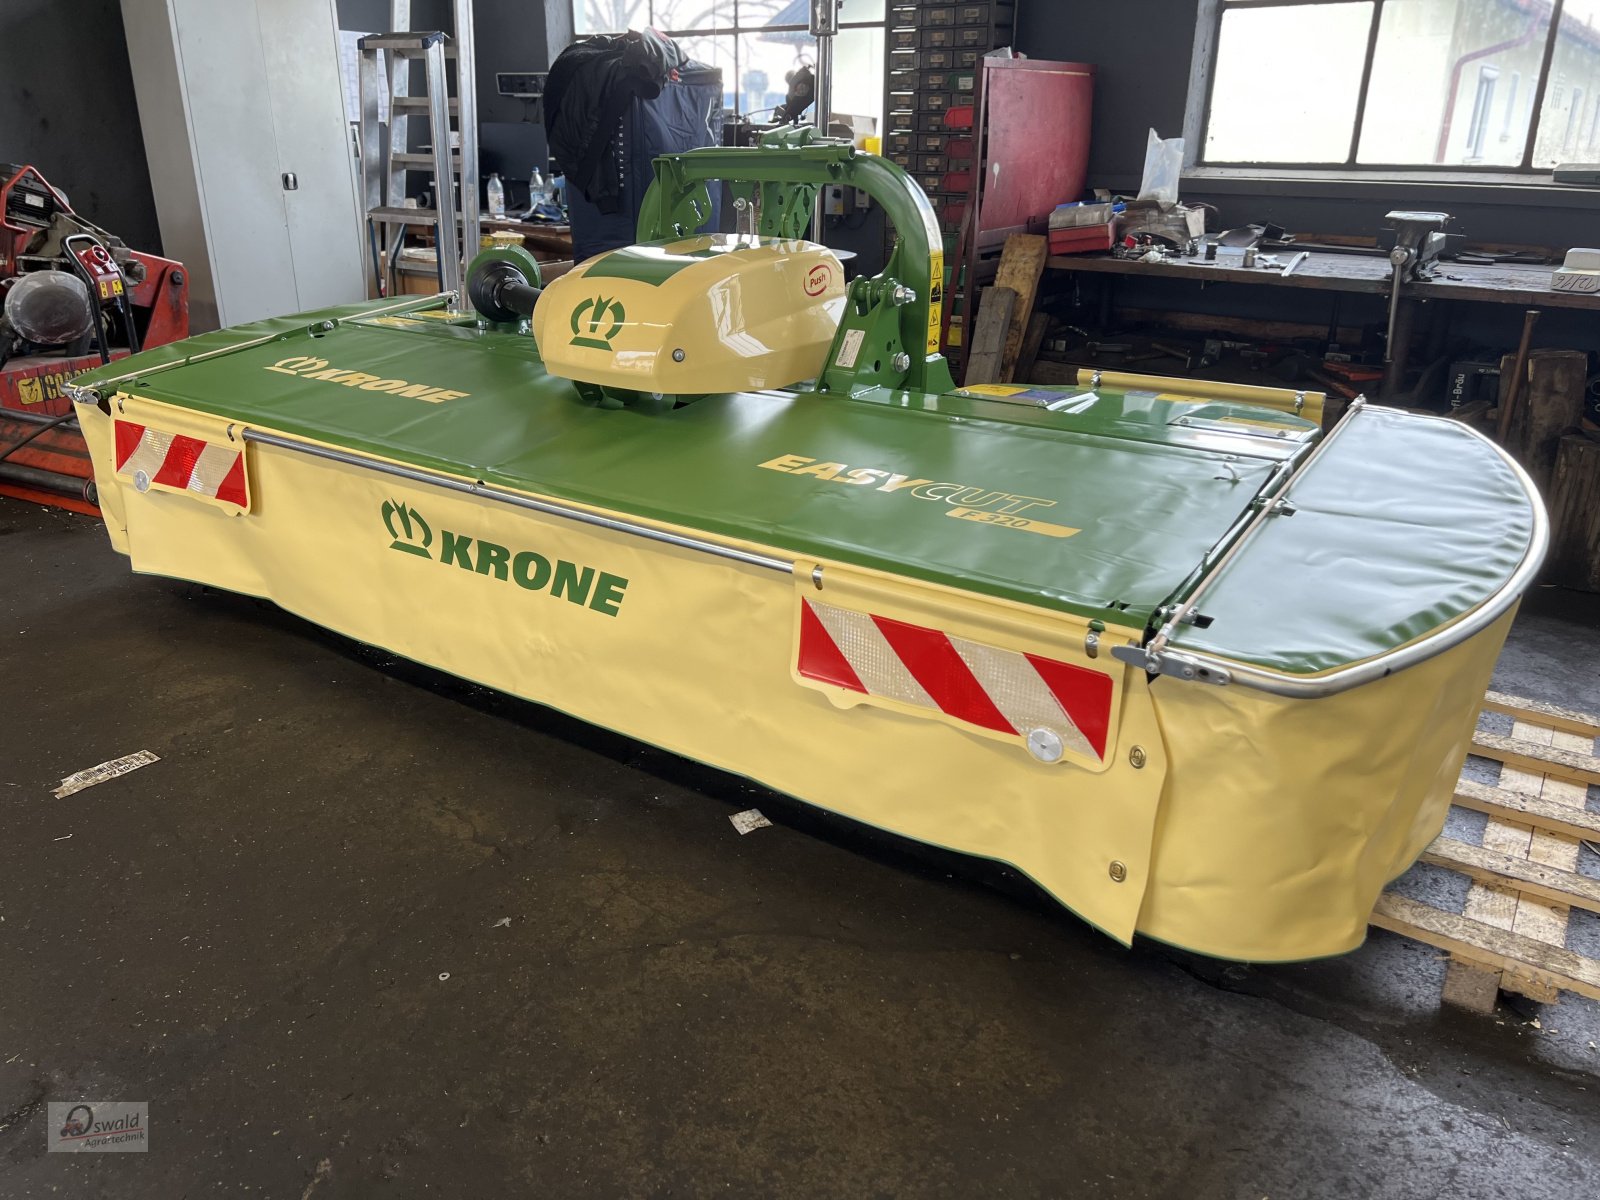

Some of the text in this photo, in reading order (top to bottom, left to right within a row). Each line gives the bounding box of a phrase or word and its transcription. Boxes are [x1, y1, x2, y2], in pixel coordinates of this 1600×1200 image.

[810, 272, 826, 288] Push
[301, 368, 471, 404] KRONE
[1451, 373, 1465, 408] fl-Bräu
[980, 511, 1030, 529] 320
[439, 529, 629, 618] KRONE
